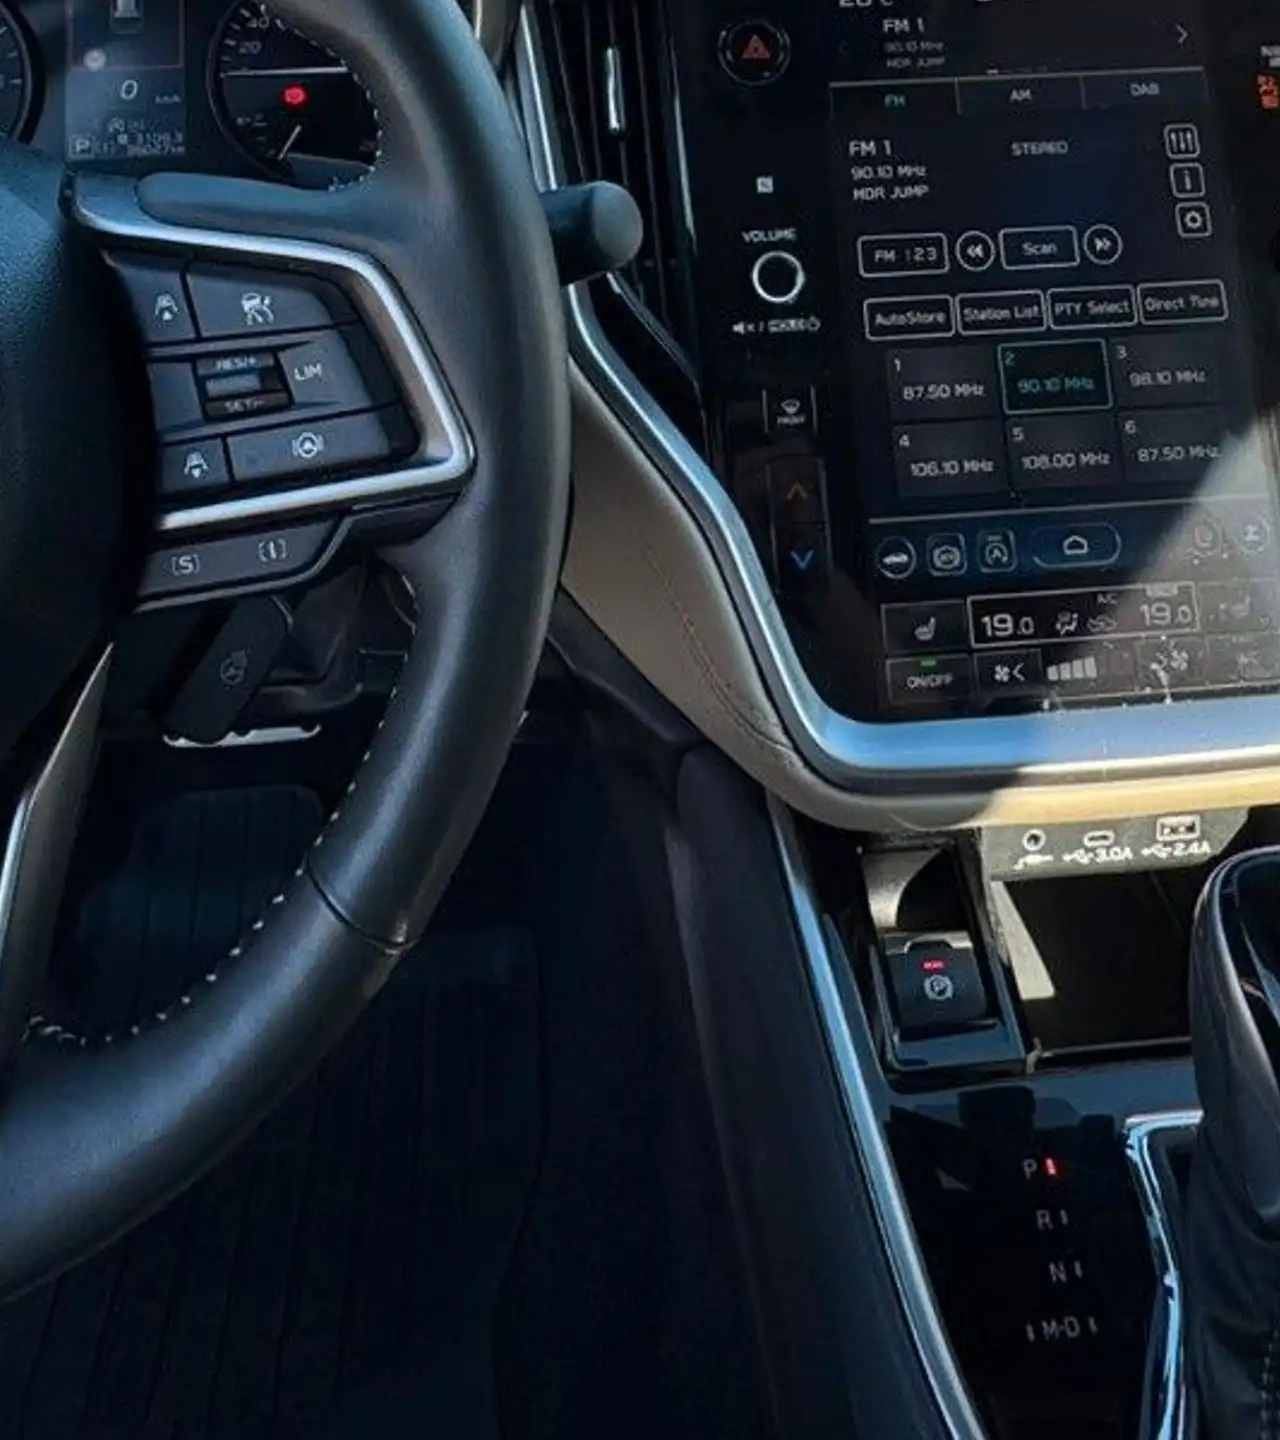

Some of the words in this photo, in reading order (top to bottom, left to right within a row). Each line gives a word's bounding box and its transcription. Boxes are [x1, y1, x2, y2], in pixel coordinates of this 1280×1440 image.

[882, 18, 911, 34] FM
[238, 40, 263, 55] 20
[120, 79, 138, 100] 0
[1009, 89, 1032, 102] AM
[884, 93, 907, 107] FM
[848, 139, 876, 157] FM
[883, 139, 893, 156] 1
[1011, 140, 1069, 156] STEREO
[850, 165, 893, 181] 90.10
[897, 163, 927, 179] MHz
[853, 186, 886, 202] MDR
[889, 184, 931, 201] JUMP
[740, 227, 798, 243] VOLUME
[874, 249, 896, 262] FM
[1021, 241, 1058, 257] Scan
[1054, 302, 1081, 316] PTY
[1086, 299, 1130, 316] Select
[1144, 296, 1186, 312] Direct
[963, 305, 1011, 323] Station
[1004, 351, 1016, 366] 2
[293, 362, 323, 382] LIM
[1175, 369, 1207, 385] MHz
[902, 383, 951, 401] 87.50
[954, 382, 985, 398] MHz
[1064, 376, 1096, 391] MHz
[1011, 426, 1025, 443] 5
[1124, 420, 1137, 436] 6
[898, 432, 910, 449] 4
[1078, 451, 1111, 467] MHz
[1136, 446, 1186, 464] 87.50
[963, 458, 995, 474] MHz
[980, 611, 1037, 638] 19.0
[1139, 600, 1193, 627] 19.0
[1022, 1159, 1039, 1181] P
[1035, 1209, 1054, 1231] R
[1048, 1261, 1068, 1284] N
